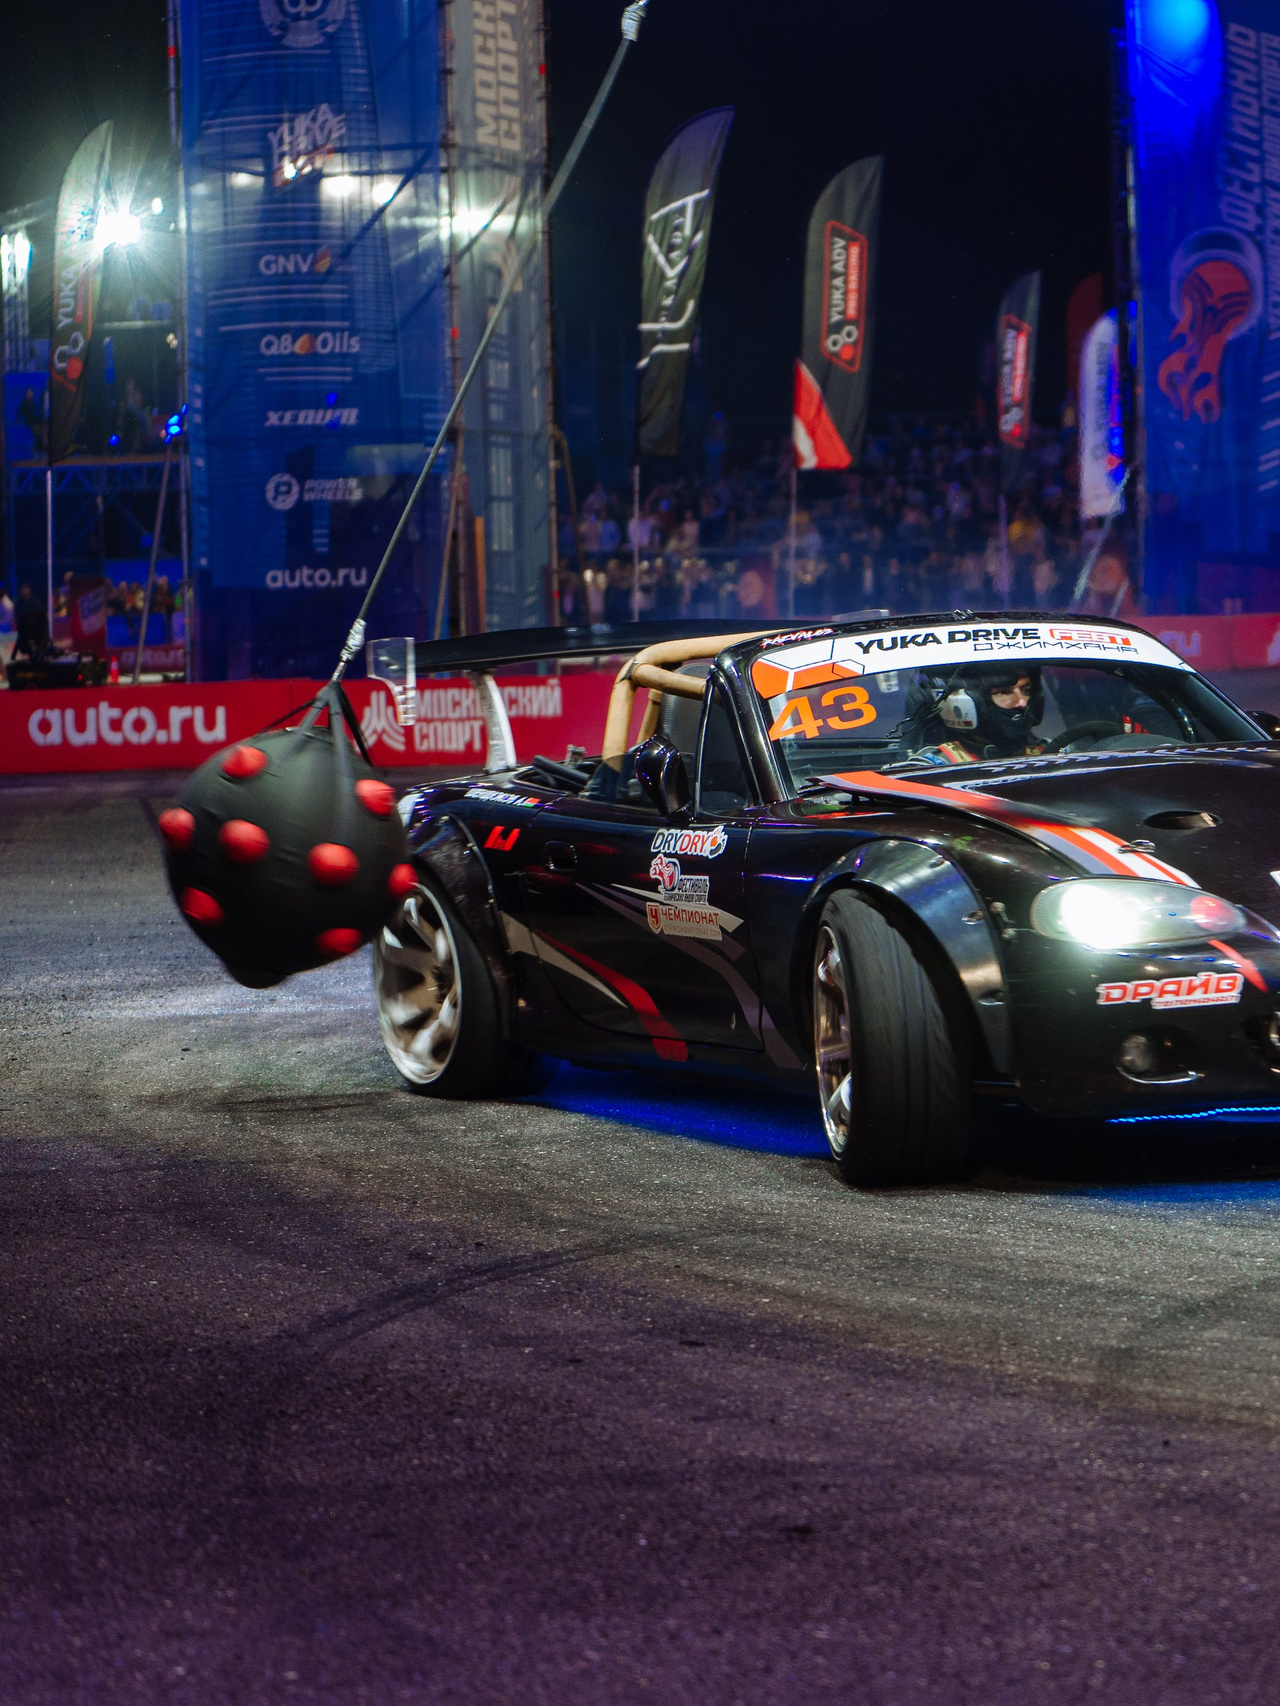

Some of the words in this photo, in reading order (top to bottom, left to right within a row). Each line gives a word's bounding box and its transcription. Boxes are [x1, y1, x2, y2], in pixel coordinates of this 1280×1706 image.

[259, 253, 314, 275] GNV
[832, 236, 847, 272] ADV
[57, 264, 78, 330] YUKA
[829, 275, 846, 325] YUKA
[265, 565, 367, 588] auto.ru
[855, 631, 942, 654] YUKA
[948, 628, 1041, 643] DRIVE
[28, 701, 226, 747] auto.ru
[768, 686, 877, 741] 43
[414, 720, 483, 752] СПОРТ
[652, 831, 710, 855] DRYDRY
[661, 908, 720, 926] ЧЕМПИОНАТ
